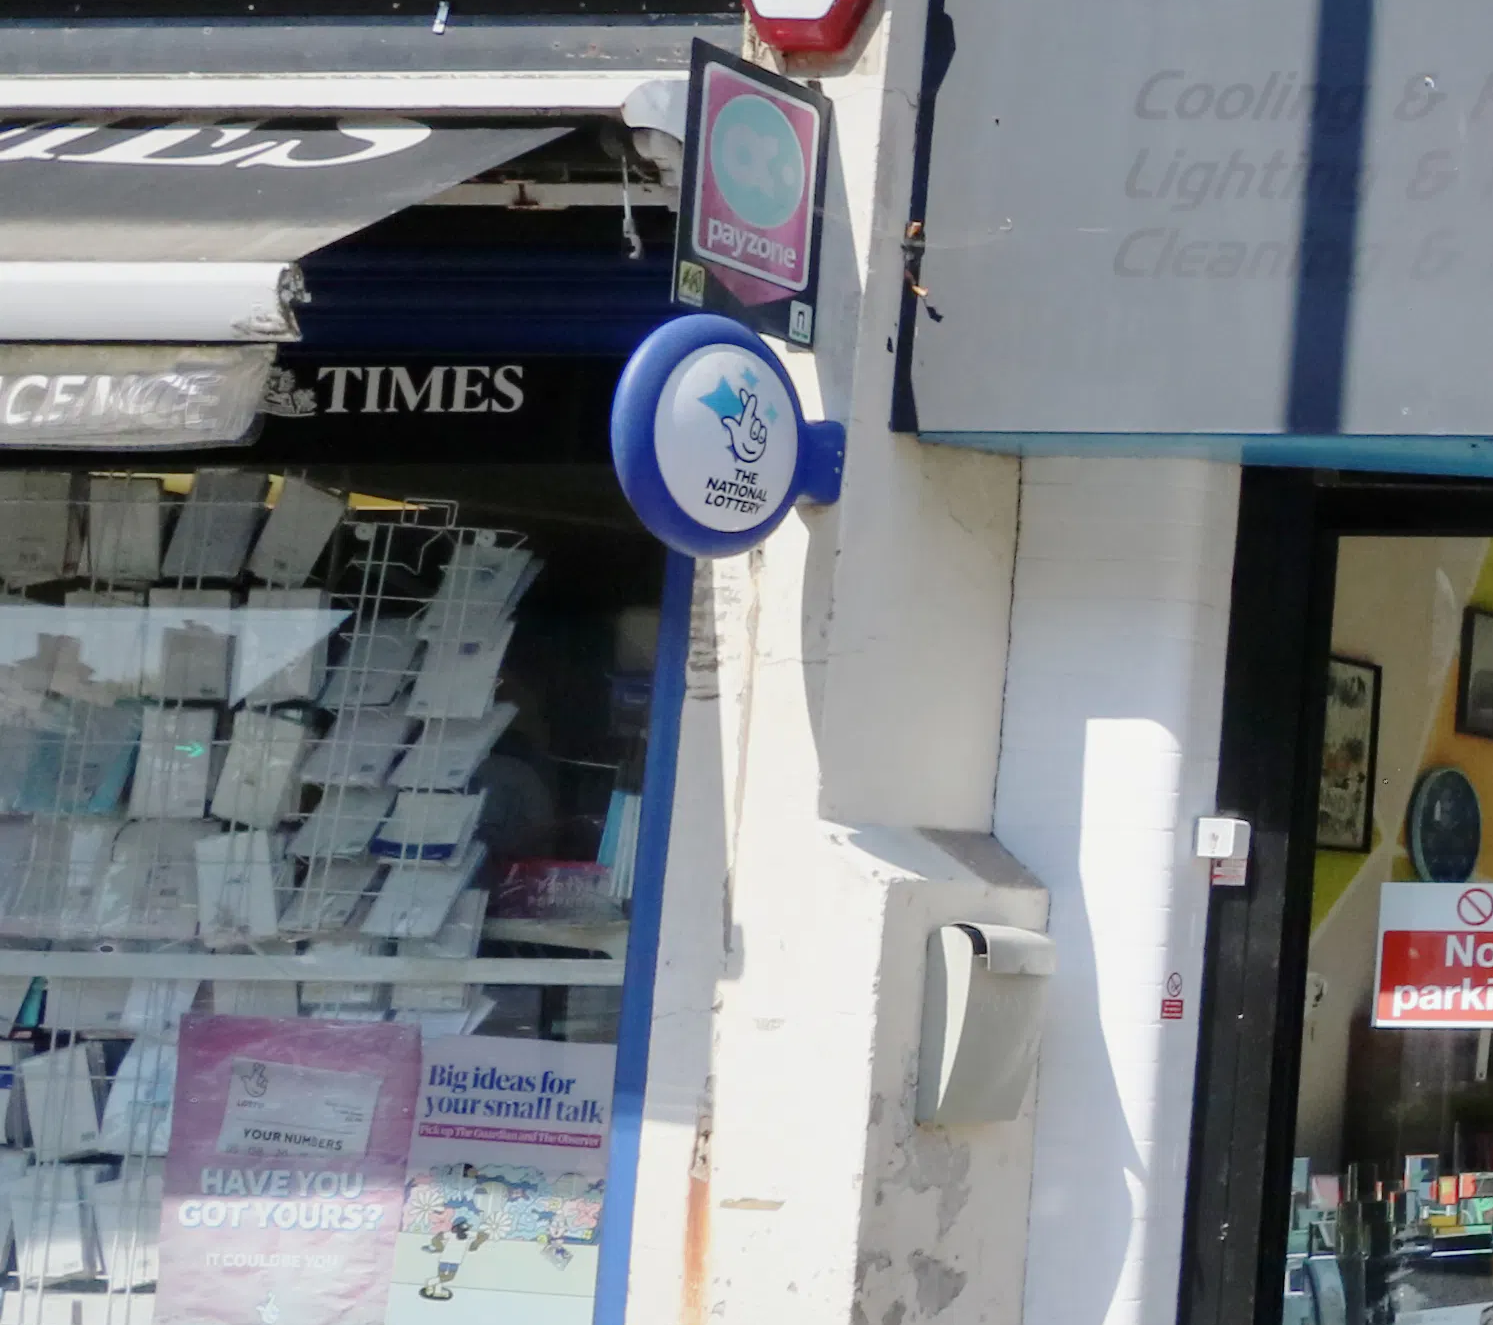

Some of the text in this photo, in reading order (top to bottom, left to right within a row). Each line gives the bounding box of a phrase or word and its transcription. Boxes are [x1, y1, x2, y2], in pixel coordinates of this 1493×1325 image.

[1133, 70, 1371, 137] Cooling
[1392, 73, 1448, 122] &
[1404, 149, 1460, 201] &
[706, 218, 798, 268] payzone
[1408, 226, 1463, 282] &
[317, 364, 526, 414] TIMES
[705, 477, 768, 502] NATIONAL
[735, 468, 759, 485] THE
[704, 493, 763, 515] LOTTERY
[428, 1064, 576, 1096] Big ideas for
[424, 1095, 605, 1124] your small talk
[243, 1128, 281, 1143] YOUR
[284, 1133, 344, 1152] NUMBERS
[420, 1125, 439, 1136] Pick
[455, 1127, 473, 1138] The
[473, 1128, 518, 1141] Guardian
[518, 1130, 537, 1142] and
[538, 1132, 556, 1143] The
[557, 1134, 600, 1147] Observer
[202, 1168, 364, 1199] HAVE YOU
[178, 1199, 385, 1231] GOT YOURS?
[206, 1253, 220, 1266] IT
[223, 1253, 279, 1268] COULD
[279, 1254, 302, 1268] BE
